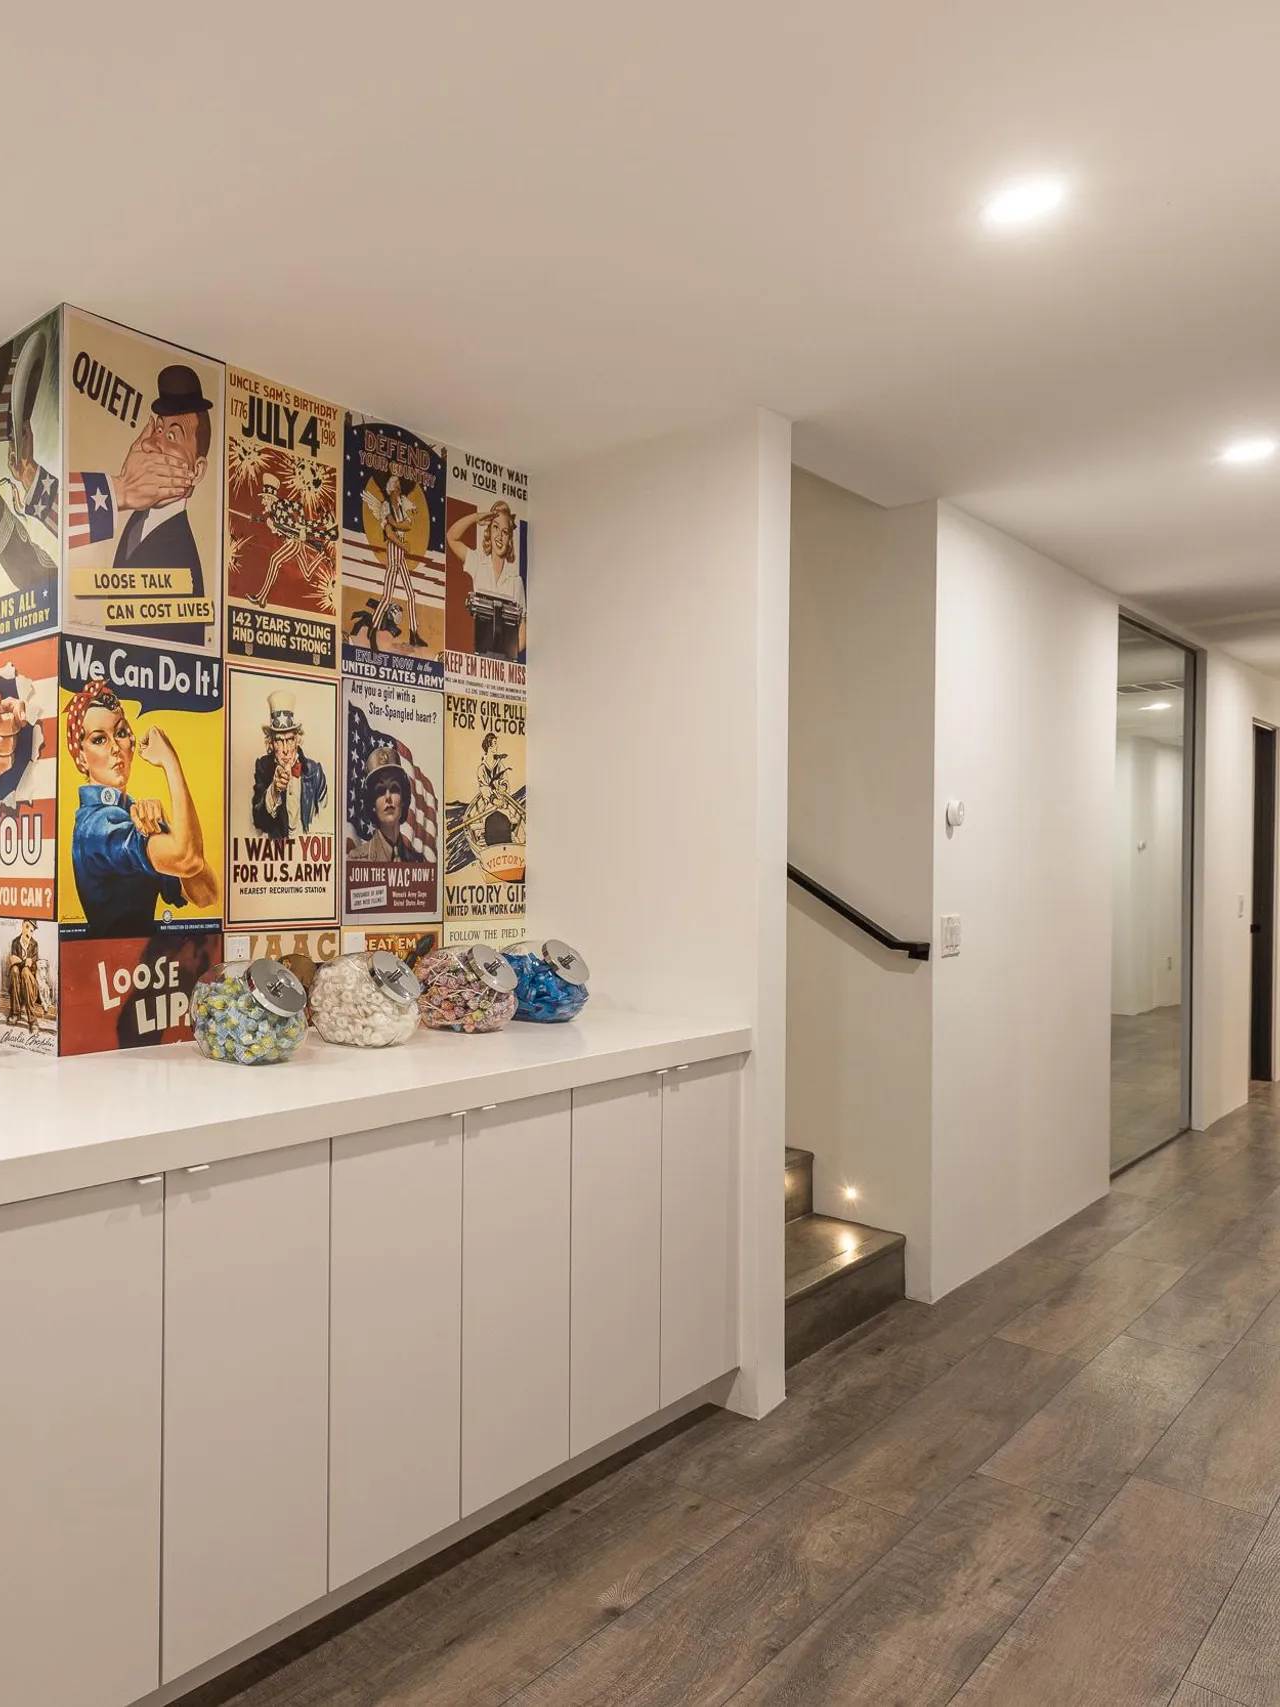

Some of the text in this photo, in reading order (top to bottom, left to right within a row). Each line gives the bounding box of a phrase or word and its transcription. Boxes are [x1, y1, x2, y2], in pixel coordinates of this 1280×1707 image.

[72, 351, 144, 429] QUIET!
[229, 373, 338, 420] UNCLE SAM'S BIRTHDAY
[231, 398, 248, 420] 1776
[241, 395, 300, 451] JULY
[298, 415, 320, 458] 4
[321, 428, 336, 447] 1918
[364, 429, 431, 471] DEFEND
[359, 449, 437, 488] YOUR COUNTRY
[464, 453, 528, 486] VICTORY WAIT
[452, 466, 528, 501] ON YOUR FINGE
[94, 573, 172, 589] LOOSE TALK
[18, 589, 36, 613] ALL
[106, 602, 210, 620] CAN COST LIVES
[14, 607, 51, 630] VICTORY
[232, 610, 331, 641] 142 YEARS YOUNG
[232, 626, 332, 656] AND GOING STRONG!
[65, 640, 219, 698] We Can Do It!
[341, 659, 377, 677] UNITED
[379, 667, 416, 684] STATES
[417, 673, 444, 689] ARMY
[444, 651, 463, 673] KEEP
[464, 654, 477, 677] 'EM
[508, 663, 527, 685] MISS
[351, 680, 416, 704] Are you a girl with a
[368, 701, 437, 724] Star-Spangled heart?
[446, 695, 478, 715] EVERY
[480, 700, 502, 718] GIRL
[453, 712, 525, 736] FOR VICTOR
[233, 835, 332, 862] I WANT YOU
[233, 863, 332, 883] FOR U.S. ARMY
[486, 855, 525, 870] VICTORY
[349, 867, 369, 882] JOIN
[370, 867, 386, 882] THE
[387, 867, 410, 887] WAC
[240, 886, 326, 895] NEAREST RECRUITING STATION
[445, 884, 502, 904] VICTORY
[446, 905, 469, 917] UNITED
[471, 905, 487, 916] WAR
[488, 904, 508, 915] WORK
[449, 928, 518, 942] FOLLOW THE PIED
[97, 955, 180, 1011] LOOSE
[135, 991, 191, 1035] LIP
